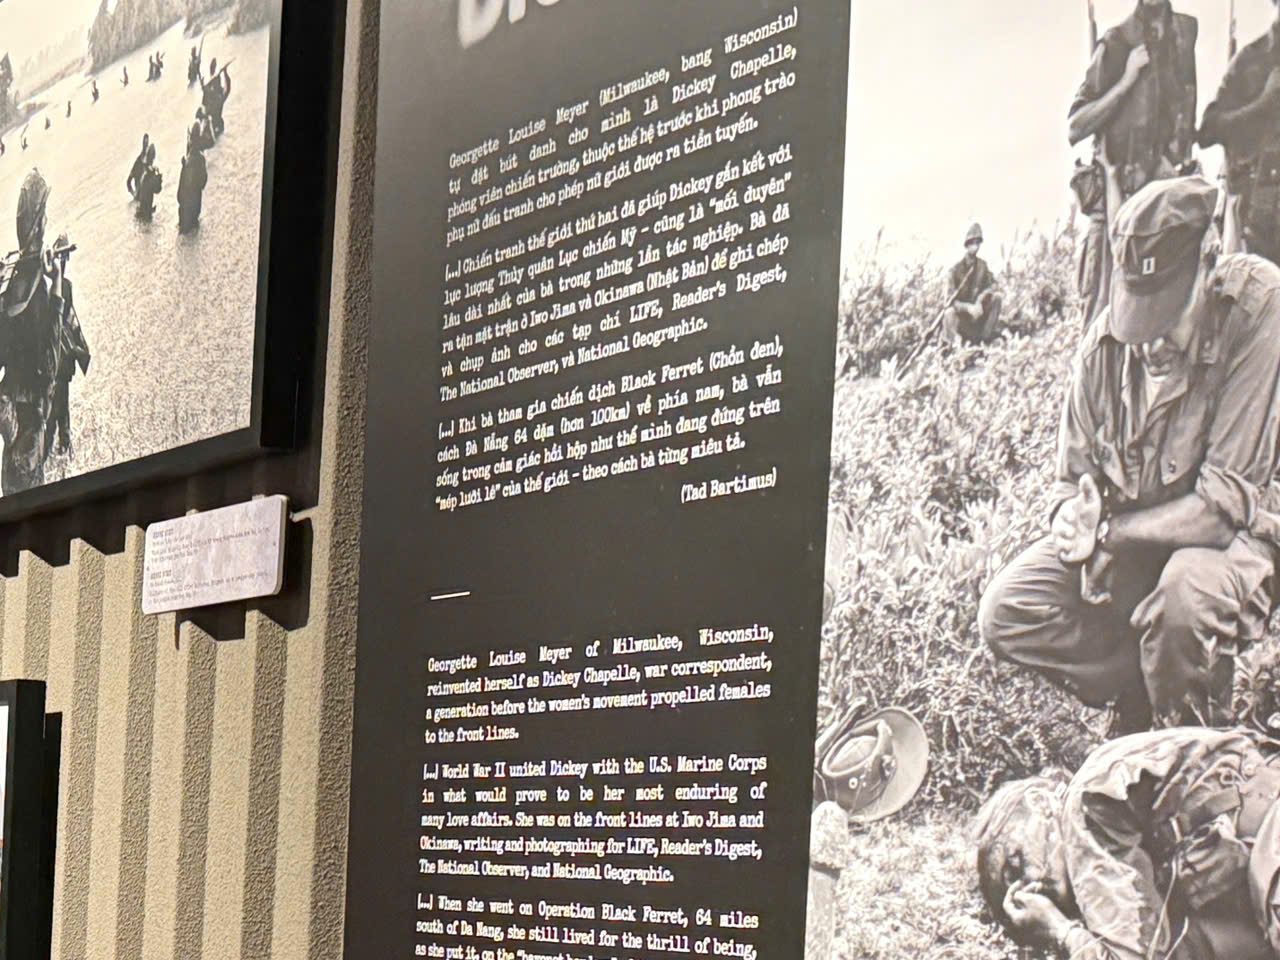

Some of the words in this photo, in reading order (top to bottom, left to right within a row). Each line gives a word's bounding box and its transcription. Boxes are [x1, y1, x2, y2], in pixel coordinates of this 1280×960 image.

[449, 138, 499, 169] Georgette
[508, 118, 546, 145] Louise
[555, 100, 589, 125] Meyer
[599, 67, 670, 107] (Milwaukee,
[681, 47, 712, 72] bang
[723, 5, 798, 54] Wisconsin)
[529, 137, 556, 161] danh
[568, 127, 589, 145] cho
[671, 73, 717, 104] Dickey
[730, 43, 797, 80] Chapelle,
[694, 97, 720, 123] khi
[721, 84, 762, 117] phong
[503, 197, 534, 222] tranh
[536, 191, 556, 209] cho
[665, 144, 681, 162] ra
[494, 239, 525, 263] tranh
[597, 204, 619, 228] hai
[669, 174, 714, 202] Dickey
[442, 339, 453, 354] ra
[529, 309, 548, 327] Iwo
[549, 301, 576, 320] Jima
[594, 280, 645, 307] Okinawa
[728, 242, 755, 270] ghi
[558, 270, 591, 293] trong
[518, 338, 537, 355] cho
[629, 298, 663, 323] LIFE,
[735, 262, 787, 292] Digest,
[439, 385, 458, 402] The
[459, 370, 506, 397] National
[507, 358, 559, 384] Observer,
[577, 334, 631, 365] National
[632, 315, 708, 349] Geographic.
[458, 415, 477, 434] Khi
[497, 407, 523, 424] tham
[526, 399, 547, 421] gia
[620, 369, 656, 393] Black
[660, 356, 704, 383] Ferret
[749, 334, 784, 360] đen),
[513, 426, 528, 445] 64
[590, 400, 630, 427] 100km)
[695, 383, 725, 403] nam,
[461, 464, 491, 482] trong
[675, 415, 708, 434] đang
[581, 463, 609, 481] theo
[680, 481, 707, 504] (Tad
[709, 466, 777, 498] Bartimus)
[427, 654, 477, 674] Georgette
[488, 649, 526, 667] Louise
[538, 645, 572, 665] Meyer
[585, 639, 600, 657] of
[612, 633, 683, 655] Milwaukee,
[698, 623, 774, 646] Wisconsin,
[426, 676, 482, 696] reinvented
[483, 672, 526, 692] herself
[526, 675, 540, 688] as
[542, 669, 581, 688] Dickey
[583, 663, 641, 686] Chapelle,
[643, 663, 668, 678] war
[670, 650, 772, 678] correspondent,
[425, 708, 432, 720] a
[433, 701, 489, 723] generation
[490, 699, 526, 716] before
[527, 697, 546, 713] the
[592, 688, 648, 709] movement
[649, 683, 716, 710] propelled
[717, 679, 771, 701] females
[424, 728, 437, 744] to
[437, 727, 455, 743] the
[455, 725, 485, 742] front
[485, 724, 520, 741] lines.
[441, 763, 469, 779] World
[472, 762, 492, 778] War
[493, 761, 506, 778] II
[508, 760, 546, 777] united
[549, 759, 589, 780] Dickey
[591, 757, 620, 775] with
[623, 757, 645, 774] the
[649, 755, 672, 773] U.S.
[676, 754, 724, 773] Marine
[727, 753, 767, 775] Corps
[421, 788, 434, 803] in
[442, 787, 467, 803] what
[474, 786, 507, 802] would
[514, 789, 547, 806] prove
[556, 785, 570, 802] to
[579, 784, 594, 801] be
[603, 784, 625, 801] her
[635, 783, 664, 801] most
[674, 782, 738, 804] enduring
[749, 780, 768, 799] of
[420, 814, 445, 830] many
[445, 811, 469, 827] love
[470, 810, 513, 827] affairs.
[514, 811, 534, 827] She
[535, 814, 555, 827] was
[556, 814, 571, 827] on
[573, 810, 593, 827] the
[593, 810, 627, 828] front
[628, 810, 663, 828] lines
[665, 810, 680, 828] at
[680, 810, 704, 828] Iwo
[705, 810, 737, 828] Jima
[738, 810, 764, 828] and
[463, 835, 504, 855] writing
[504, 836, 524, 852] and
[524, 836, 605, 858] photographing
[605, 837, 626, 854] for
[626, 837, 659, 858] LIFE,
[713, 838, 762, 861] Digest,
[418, 858, 436, 874] The
[436, 859, 480, 875] National
[481, 860, 530, 880] Observer,
[530, 862, 551, 878] and
[552, 862, 602, 880] National
[603, 863, 674, 886] Geographic.
[437, 895, 462, 911] When
[466, 896, 484, 912] she
[488, 898, 514, 915] went
[518, 903, 533, 916] on
[538, 900, 595, 921] Operation
[601, 903, 637, 922] Black
[642, 905, 688, 928] Ferret,
[695, 907, 712, 926] 64
[719, 910, 759, 929] miles
[414, 943, 427, 956] as
[427, 942, 445, 958] she
[415, 918, 444, 934] south
[446, 919, 459, 935] of
[460, 919, 474, 936] Da
[475, 921, 505, 942] Nang,
[506, 923, 526, 940] she
[528, 925, 560, 943] still
[561, 927, 595, 945] lived
[597, 929, 619, 947] for
[621, 931, 643, 949] the
[646, 932, 691, 953] thrill
[694, 936, 711, 954] of
